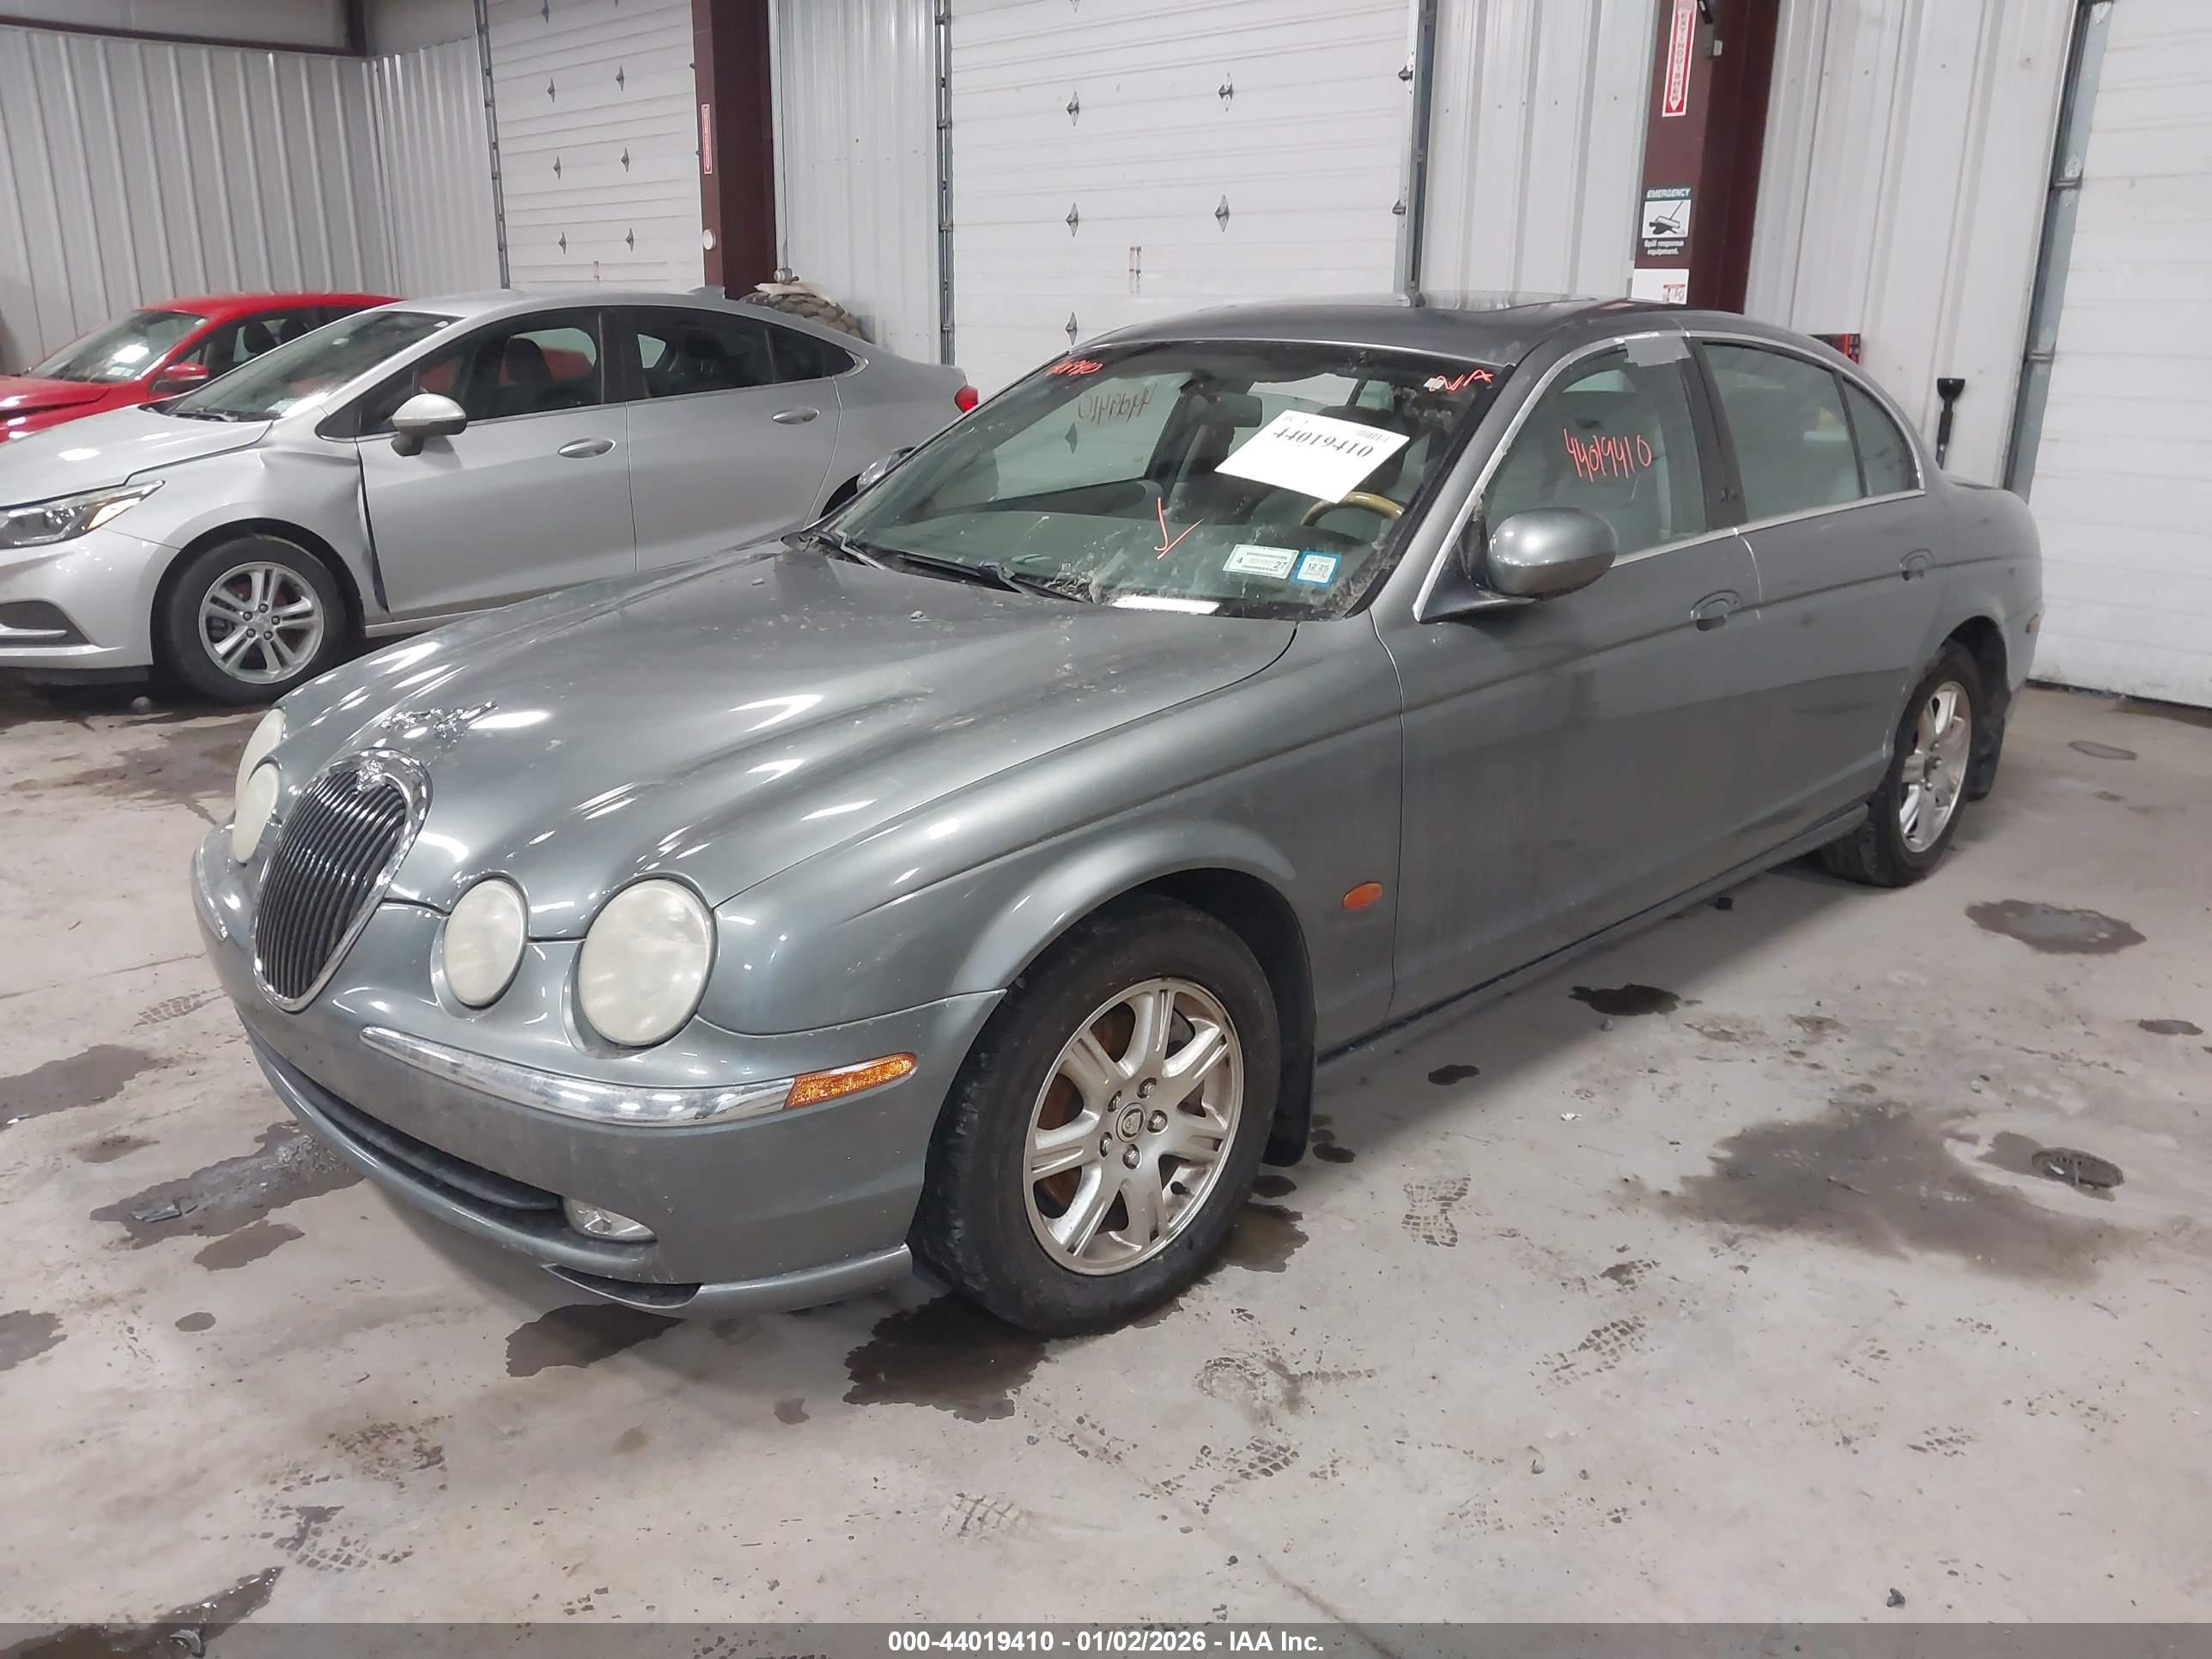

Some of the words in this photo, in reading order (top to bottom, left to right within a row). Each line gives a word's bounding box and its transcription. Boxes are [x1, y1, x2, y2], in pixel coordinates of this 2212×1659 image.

[1646, 187, 1692, 198] EMERGENCY
[1273, 427, 1374, 458] 44019410
[1564, 428, 1652, 483] 44019410
[1273, 561, 1287, 570] 27
